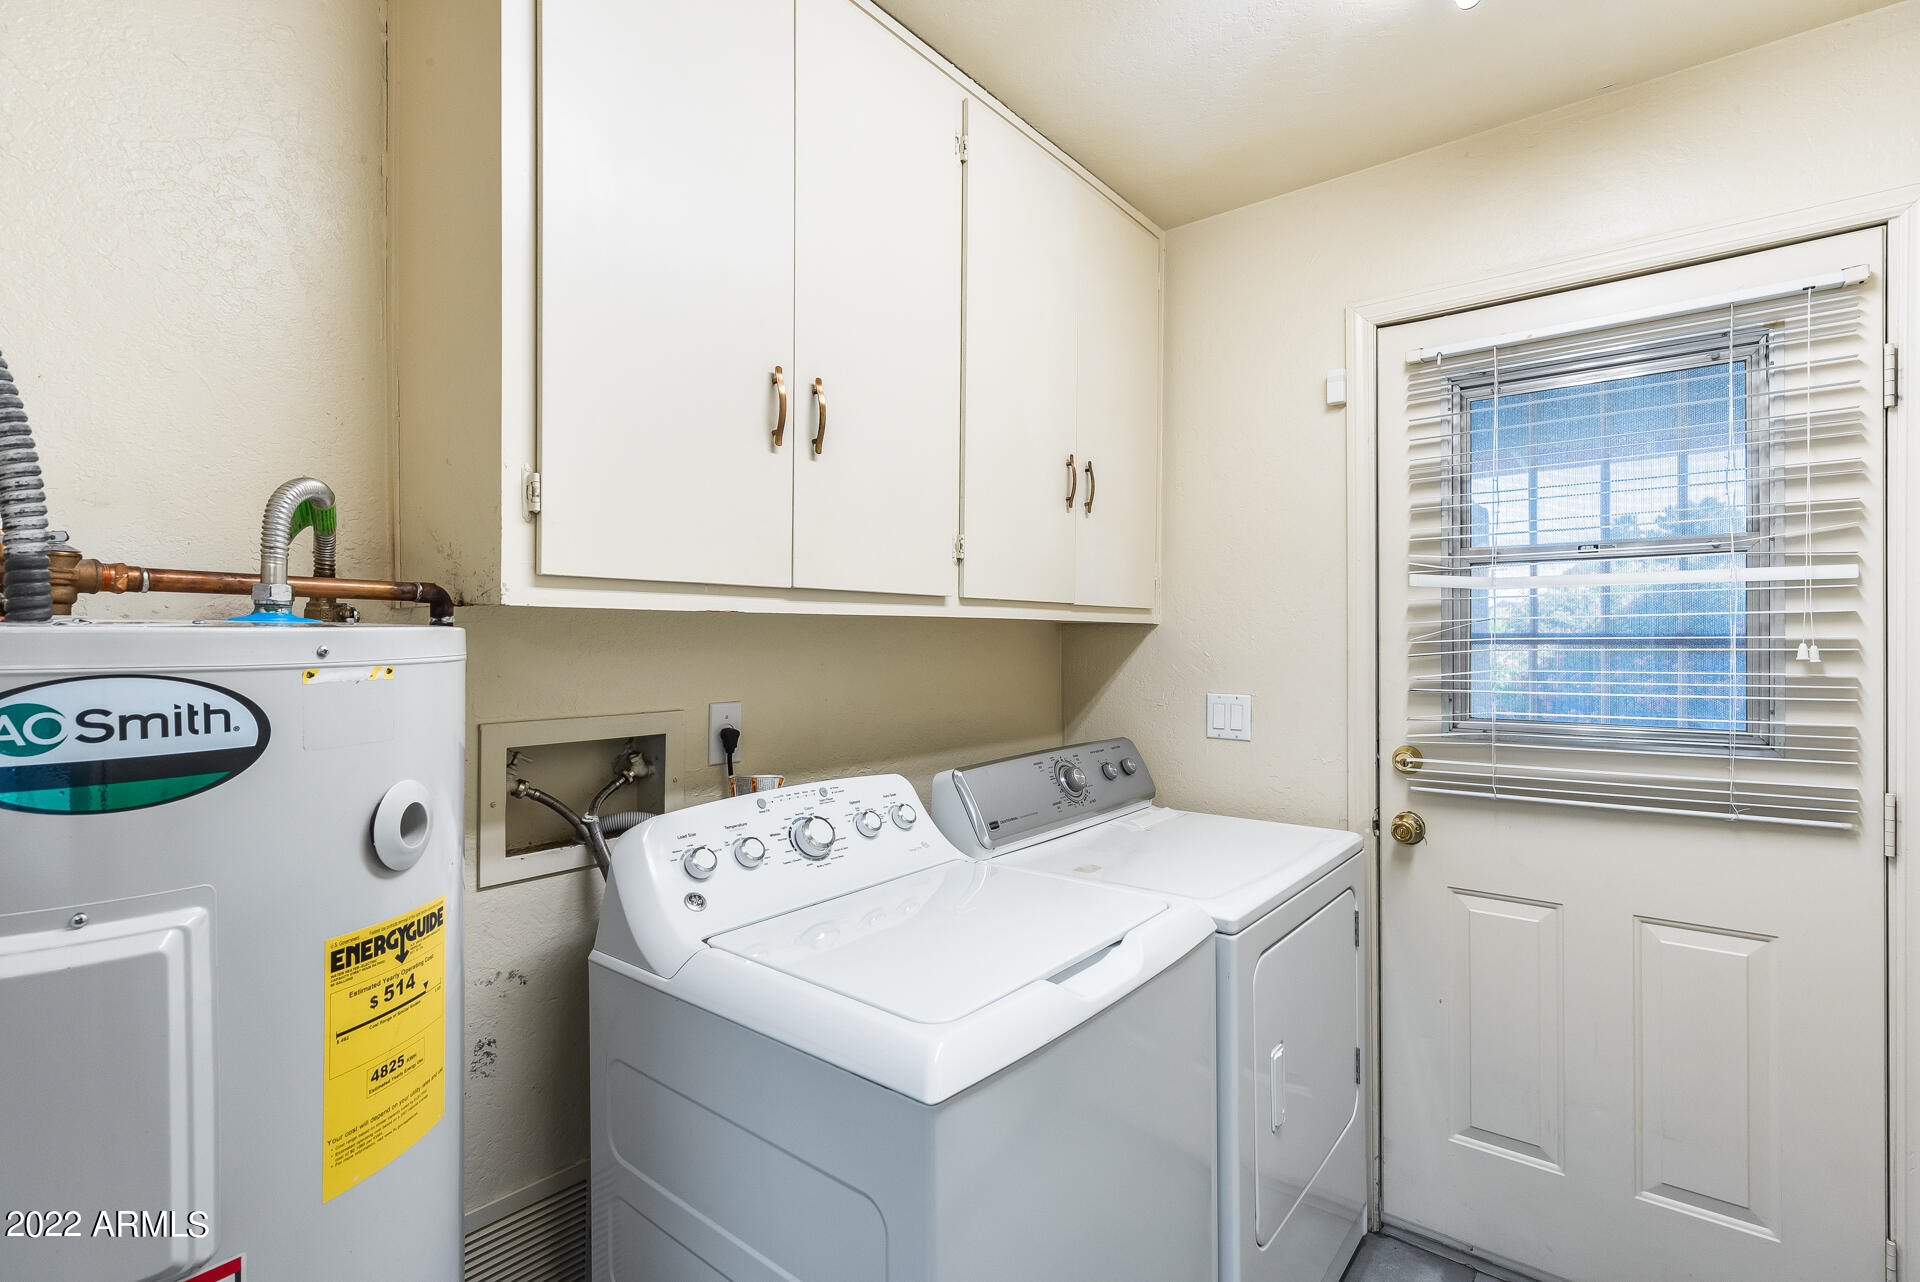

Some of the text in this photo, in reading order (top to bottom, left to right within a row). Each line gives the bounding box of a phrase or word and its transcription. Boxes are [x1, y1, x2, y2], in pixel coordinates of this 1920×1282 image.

[330, 906, 444, 973] ENERGYGUIDE
[349, 977, 381, 998] Estimated
[382, 971, 400, 984] Yearly
[401, 961, 424, 976] Operating
[424, 954, 434, 963] Cost
[369, 973, 416, 1010] $ 514
[370, 1054, 405, 1083] 4825
[327, 1134, 343, 1146] Your
[344, 1126, 358, 1138] cost
[370, 1107, 391, 1124] depend
